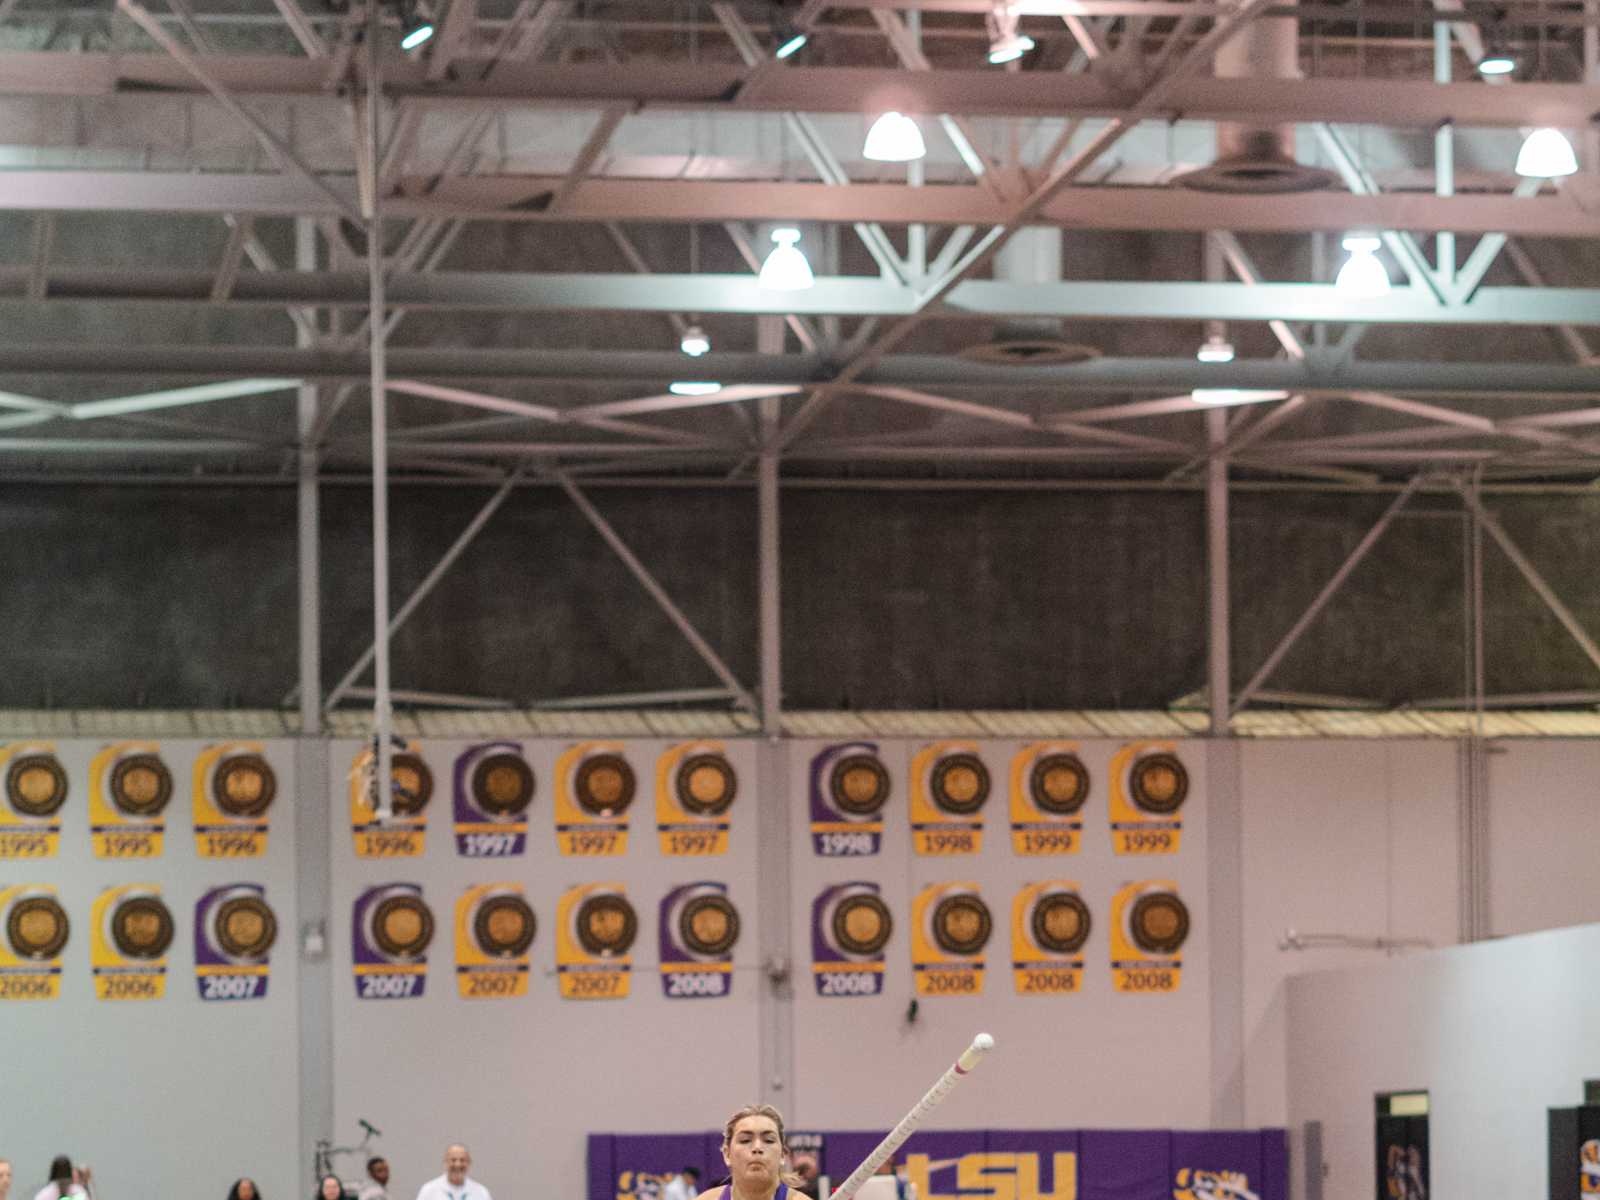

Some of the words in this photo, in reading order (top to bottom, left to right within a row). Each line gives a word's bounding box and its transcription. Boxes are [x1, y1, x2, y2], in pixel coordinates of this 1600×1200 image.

[103, 837, 153, 855] 1995
[206, 837, 257, 855] 1996
[365, 837, 415, 854] 1996
[464, 834, 516, 856] 1997
[569, 834, 617, 853] 1997
[670, 834, 718, 853] 1997
[923, 834, 973, 852] 1998
[1024, 834, 1072, 852] 1999
[1123, 834, 1171, 852] 1999
[204, 975, 258, 998] 2007
[362, 975, 417, 997] 2007
[468, 975, 519, 995] 2007
[570, 975, 621, 994] 2007
[925, 974, 976, 993] 2008
[1024, 973, 1075, 991] 2008
[1122, 973, 1173, 991] 2008
